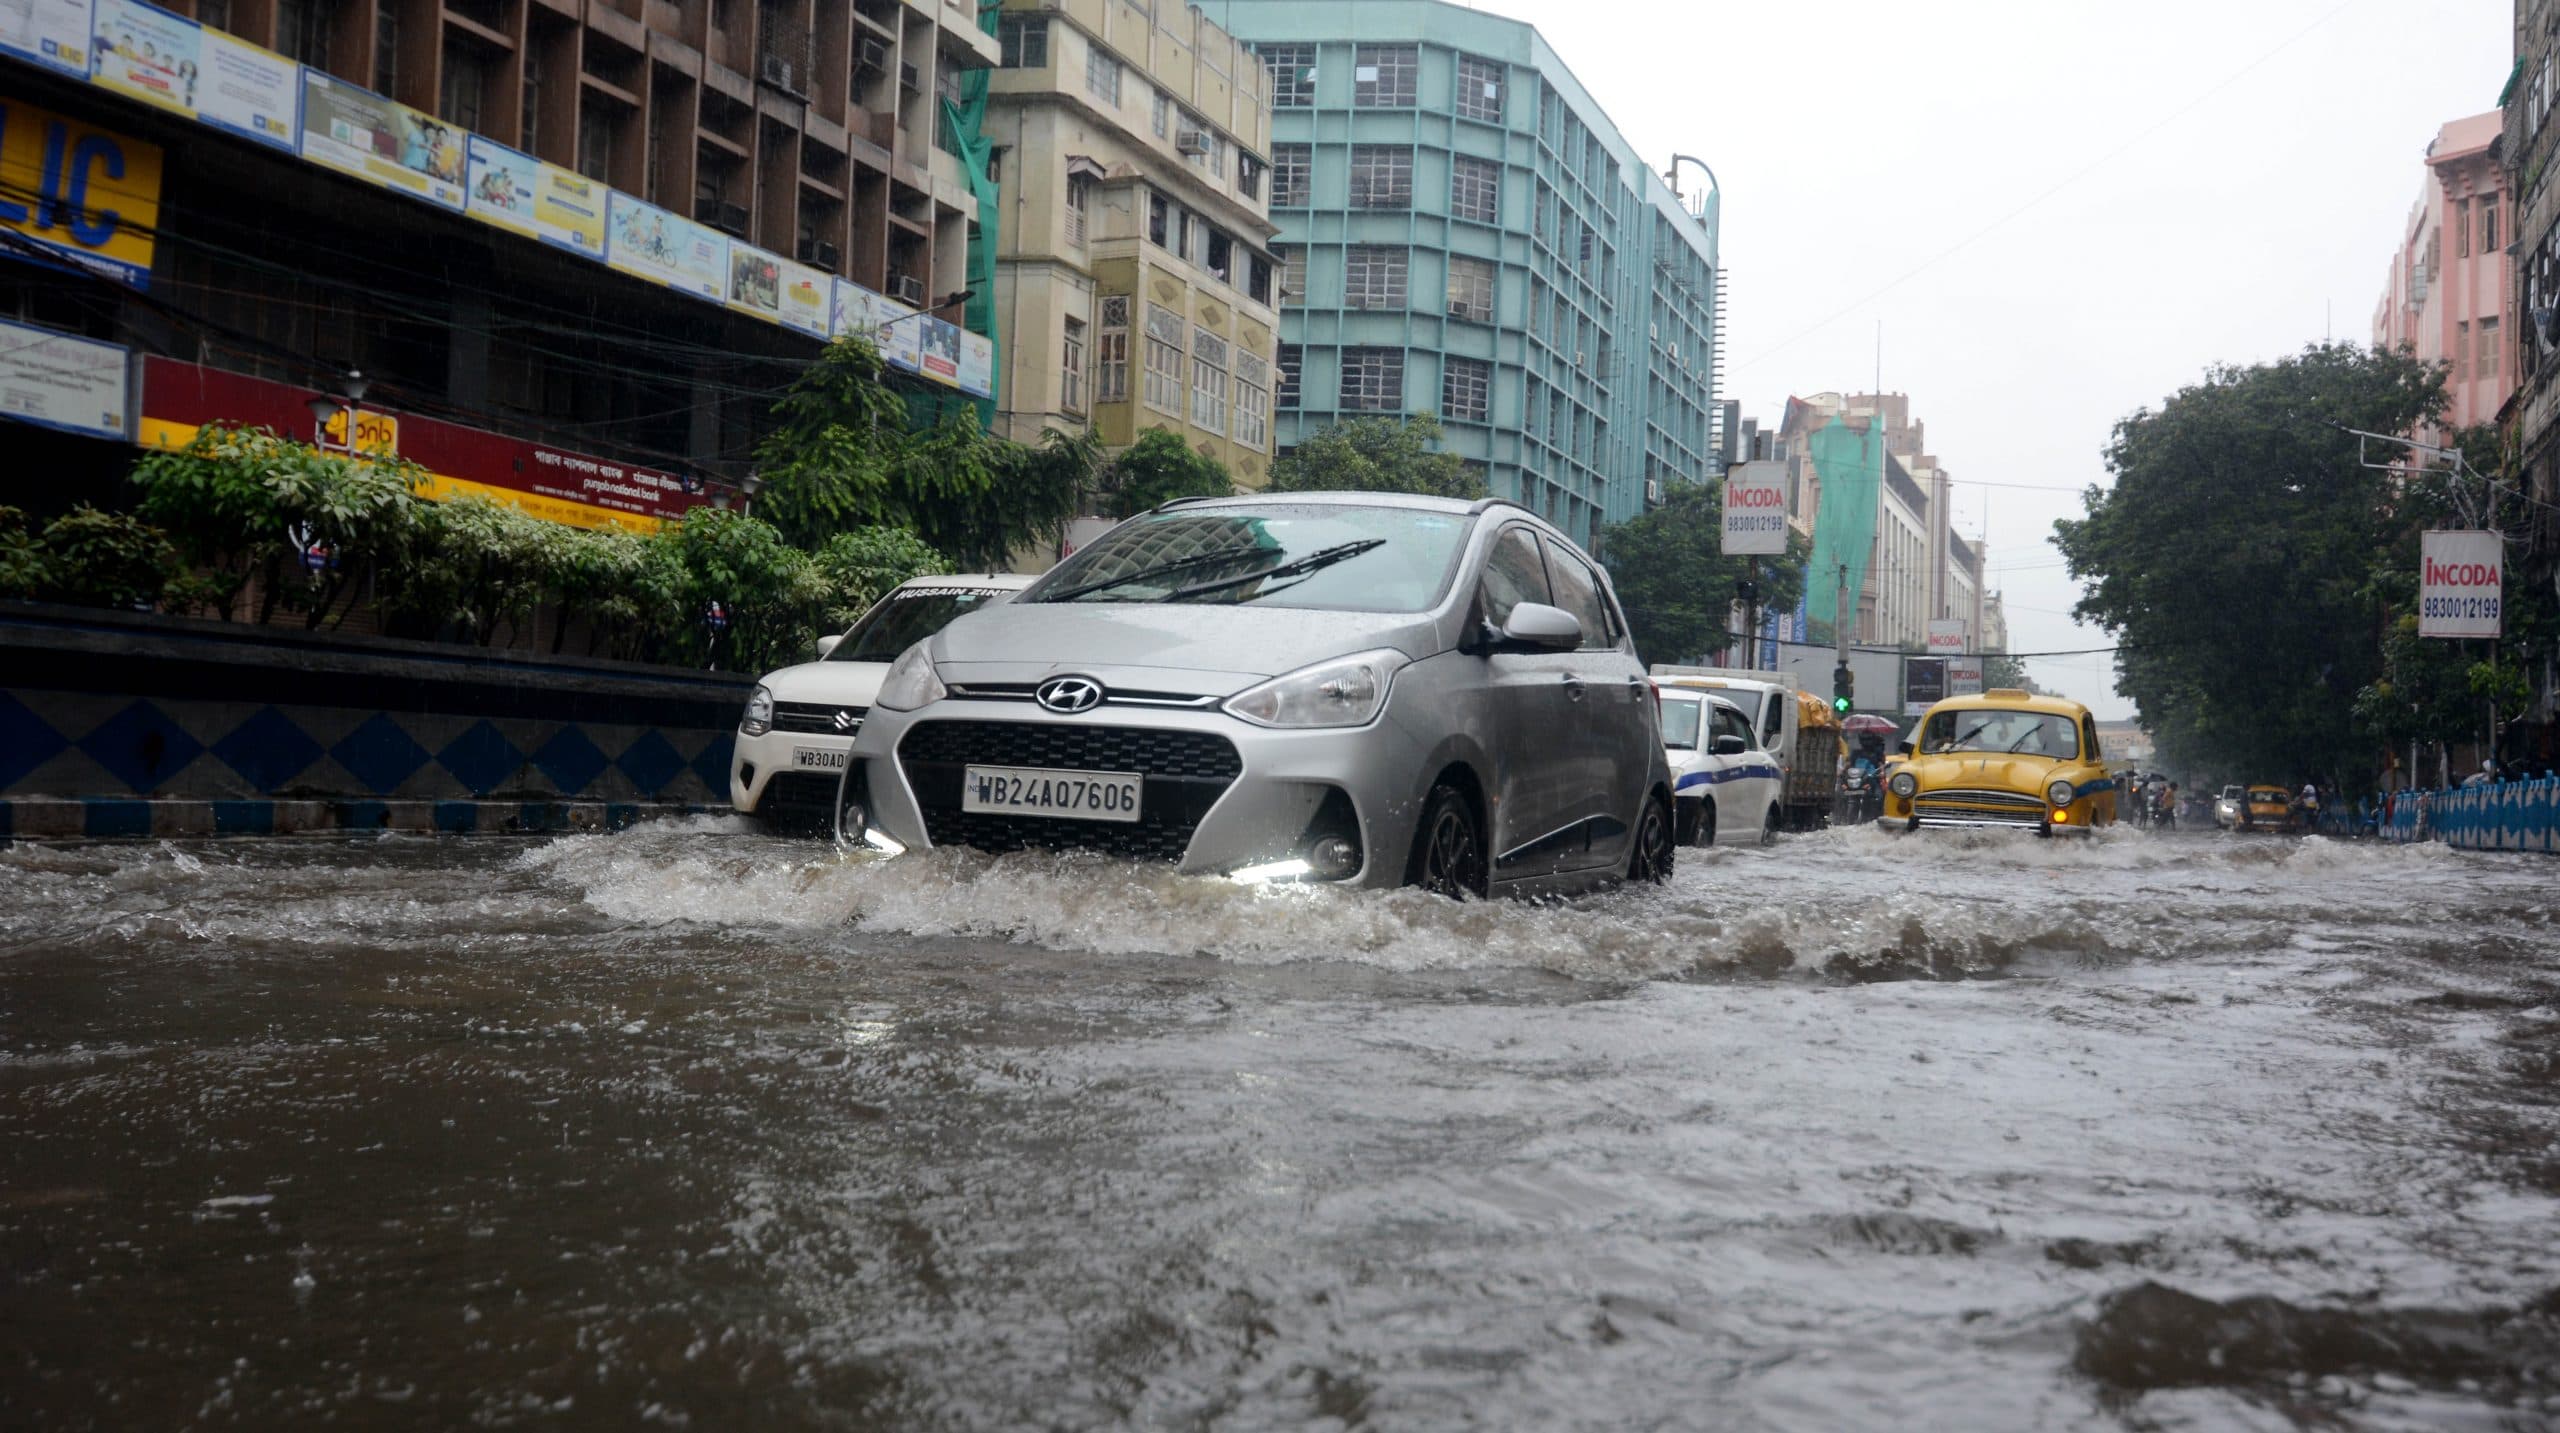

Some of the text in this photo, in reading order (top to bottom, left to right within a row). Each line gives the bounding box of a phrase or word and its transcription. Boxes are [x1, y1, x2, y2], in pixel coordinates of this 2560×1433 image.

[583, 478, 611, 493] punjab
[611, 483, 641, 499] national
[641, 488, 660, 502] bank
[1728, 516, 1783, 532] 9830012199
[894, 588, 967, 601] HUSSAIN
[2425, 597, 2498, 619] 9830012199
[800, 751, 847, 768] WB30AD
[978, 775, 1136, 812] WB24AQ7606
